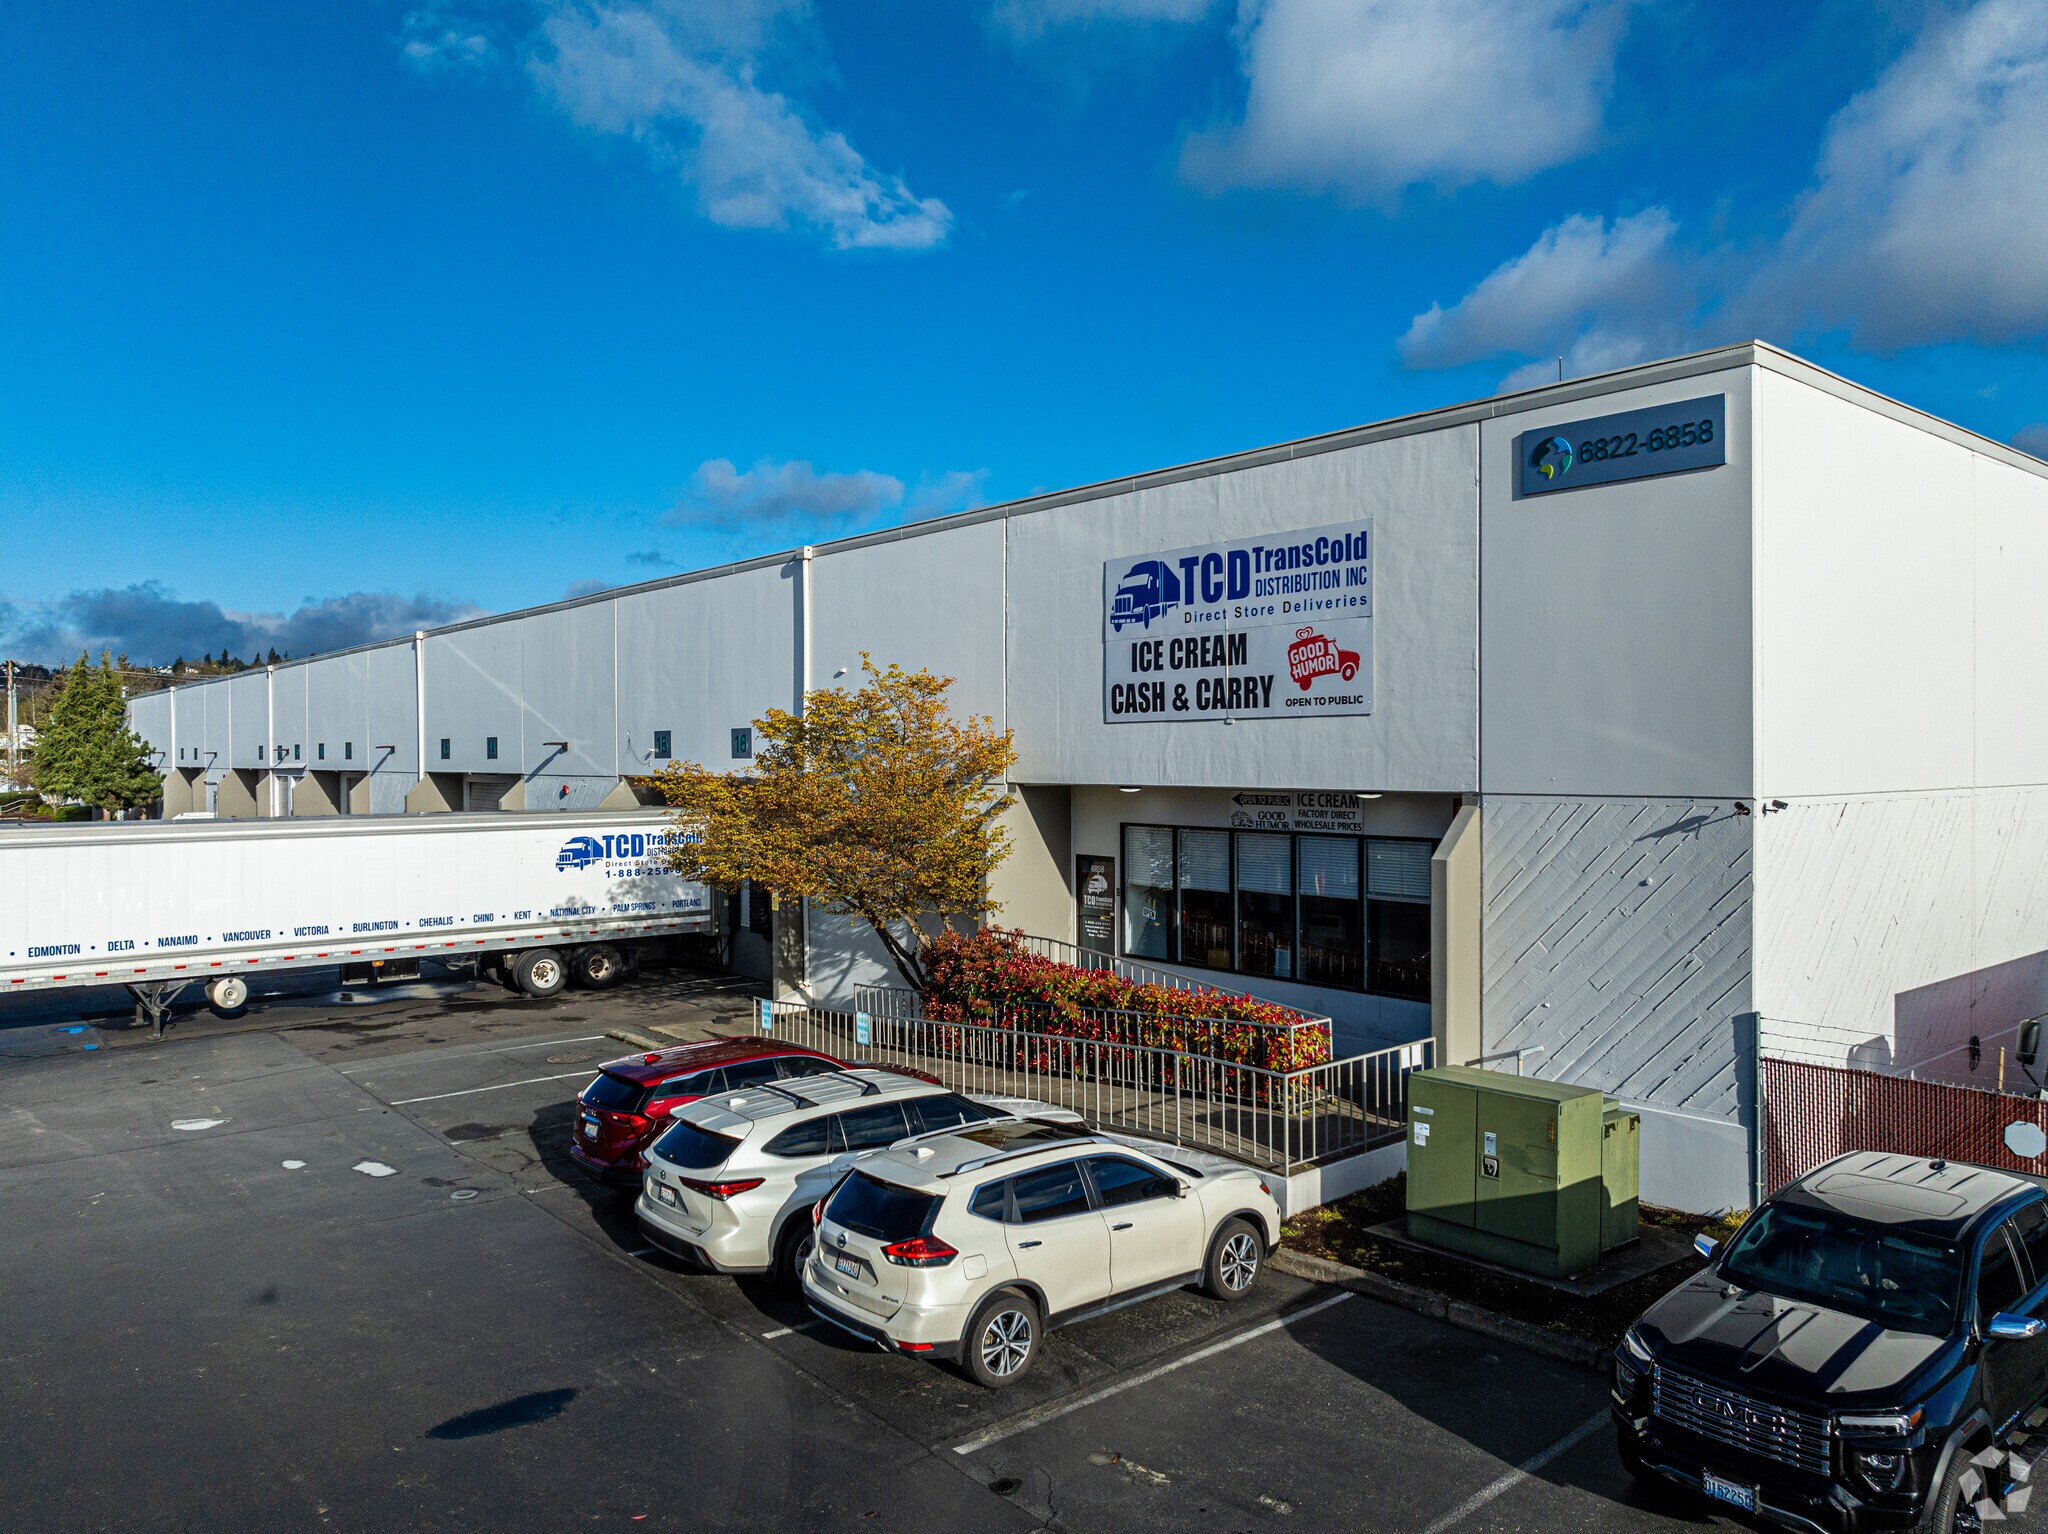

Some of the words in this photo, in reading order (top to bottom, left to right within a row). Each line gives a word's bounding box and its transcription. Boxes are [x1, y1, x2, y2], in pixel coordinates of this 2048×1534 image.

[1580, 419, 1714, 463] 6822-6858
[1252, 530, 1367, 574] TransCold
[1179, 550, 1250, 605] TCD
[1255, 569, 1341, 597] DISTRIBUTION
[1346, 566, 1367, 587] INC
[1184, 608, 1227, 624] Direct
[1234, 605, 1274, 619] Store
[1283, 594, 1367, 613] Deliveries
[1131, 639, 1164, 673] ICE
[1170, 633, 1247, 669] CREAM
[1290, 641, 1325, 664] GOOD
[1293, 655, 1335, 679] HUMOR
[1111, 682, 1166, 714] CASH
[1172, 684, 1190, 712] &
[1196, 675, 1274, 710] CARRY
[1285, 698, 1311, 707] OPEN
[1313, 697, 1326, 706] TO
[1328, 695, 1364, 705] PUBLIC
[657, 736, 668, 753] 15
[735, 734, 748, 753] 16
[1240, 795, 1256, 804] OPEN
[1258, 796, 1266, 804] TO
[1268, 796, 1290, 806] PUBLIC
[1297, 793, 1315, 807] ICE
[1318, 794, 1360, 808] CREAM
[1256, 820, 1290, 830] HUMOR
[1258, 811, 1286, 820] GOOD
[1298, 809, 1328, 819] FACTORY
[1330, 810, 1356, 820] DIRECT
[1294, 820, 1336, 830] WHOLESALE
[1338, 822, 1362, 832] PRICES
[602, 834, 644, 858] TCD
[605, 860, 632, 868] Direct
[1084, 894, 1096, 906] TCD
[28, 944, 81, 958] EDMONTON
[108, 940, 135, 952] DELTA
[158, 934, 198, 948] NANAIMO
[222, 929, 272, 942] VANCOUVER
[294, 925, 330, 937] VICTORIA
[352, 920, 398, 932] BURLINGTON
[419, 916, 454, 928] CHEHALIS
[473, 913, 494, 924] CHINO
[514, 910, 532, 920] KENT
[550, 907, 580, 917] NATIONAL
[582, 906, 596, 915] CITY
[613, 904, 630, 912] PALM
[631, 902, 656, 911] SPRINGS
[672, 898, 701, 908] PORTLAND
